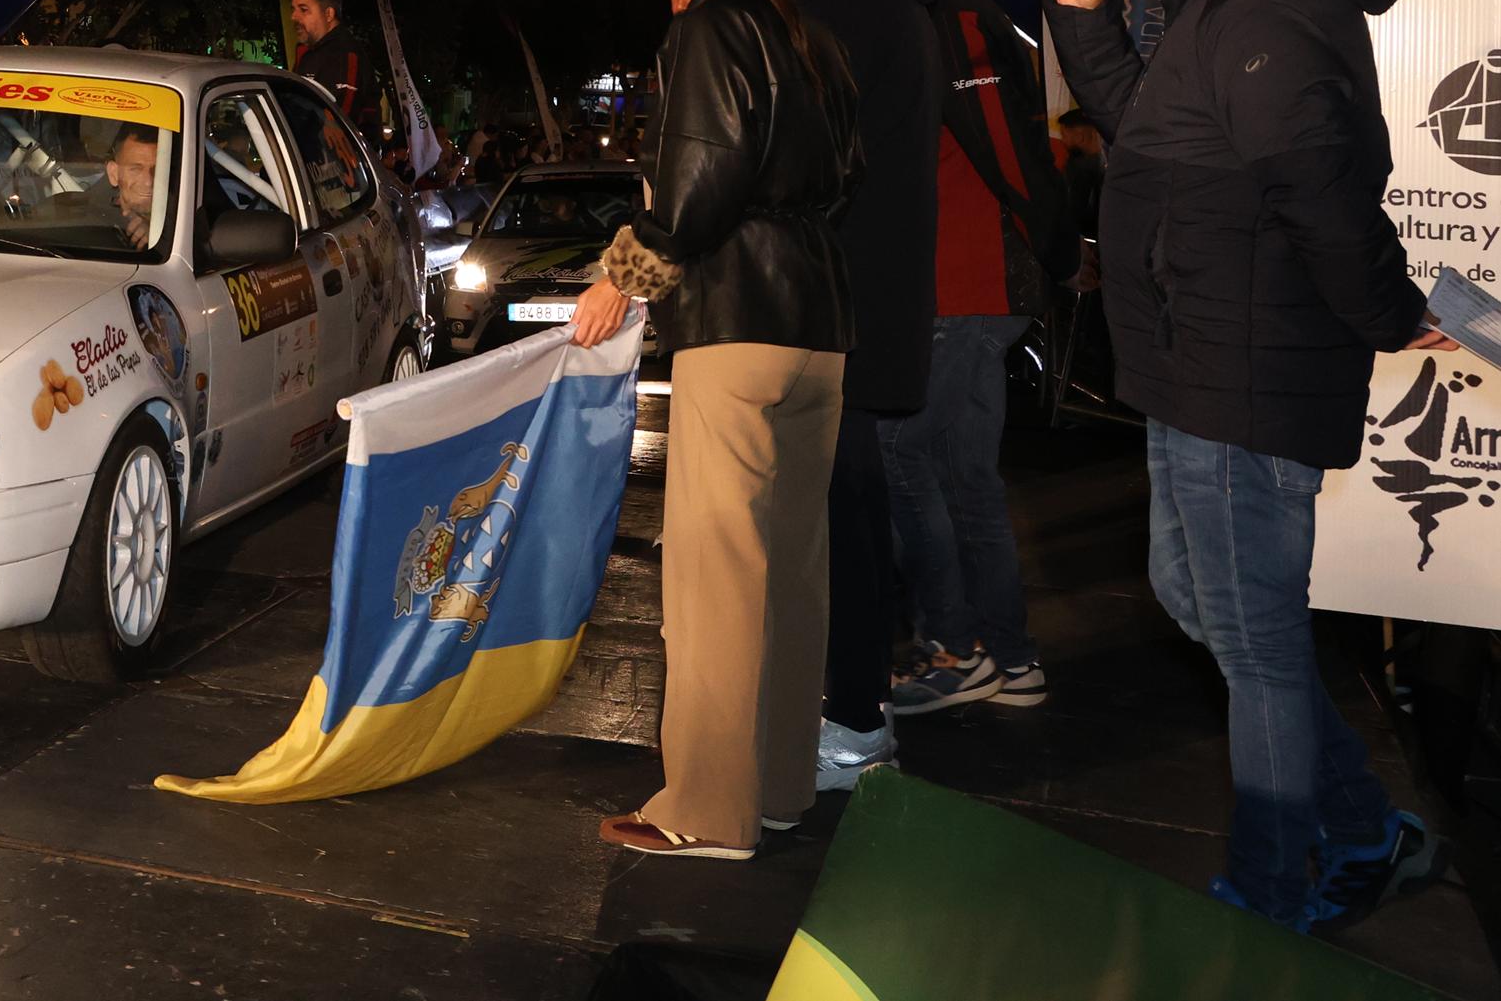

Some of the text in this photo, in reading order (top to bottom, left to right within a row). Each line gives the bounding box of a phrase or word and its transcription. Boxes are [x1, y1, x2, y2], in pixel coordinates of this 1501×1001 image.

[73, 91, 138, 105] VicNes
[1380, 187, 1487, 209] entros
[1481, 226, 1500, 251] y
[1466, 263, 1496, 282] de
[227, 273, 260, 336] 36
[519, 306, 551, 320] 8488
[71, 325, 128, 374] Eladio
[84, 372, 97, 397] El
[97, 374, 109, 391] de
[106, 362, 121, 384] las
